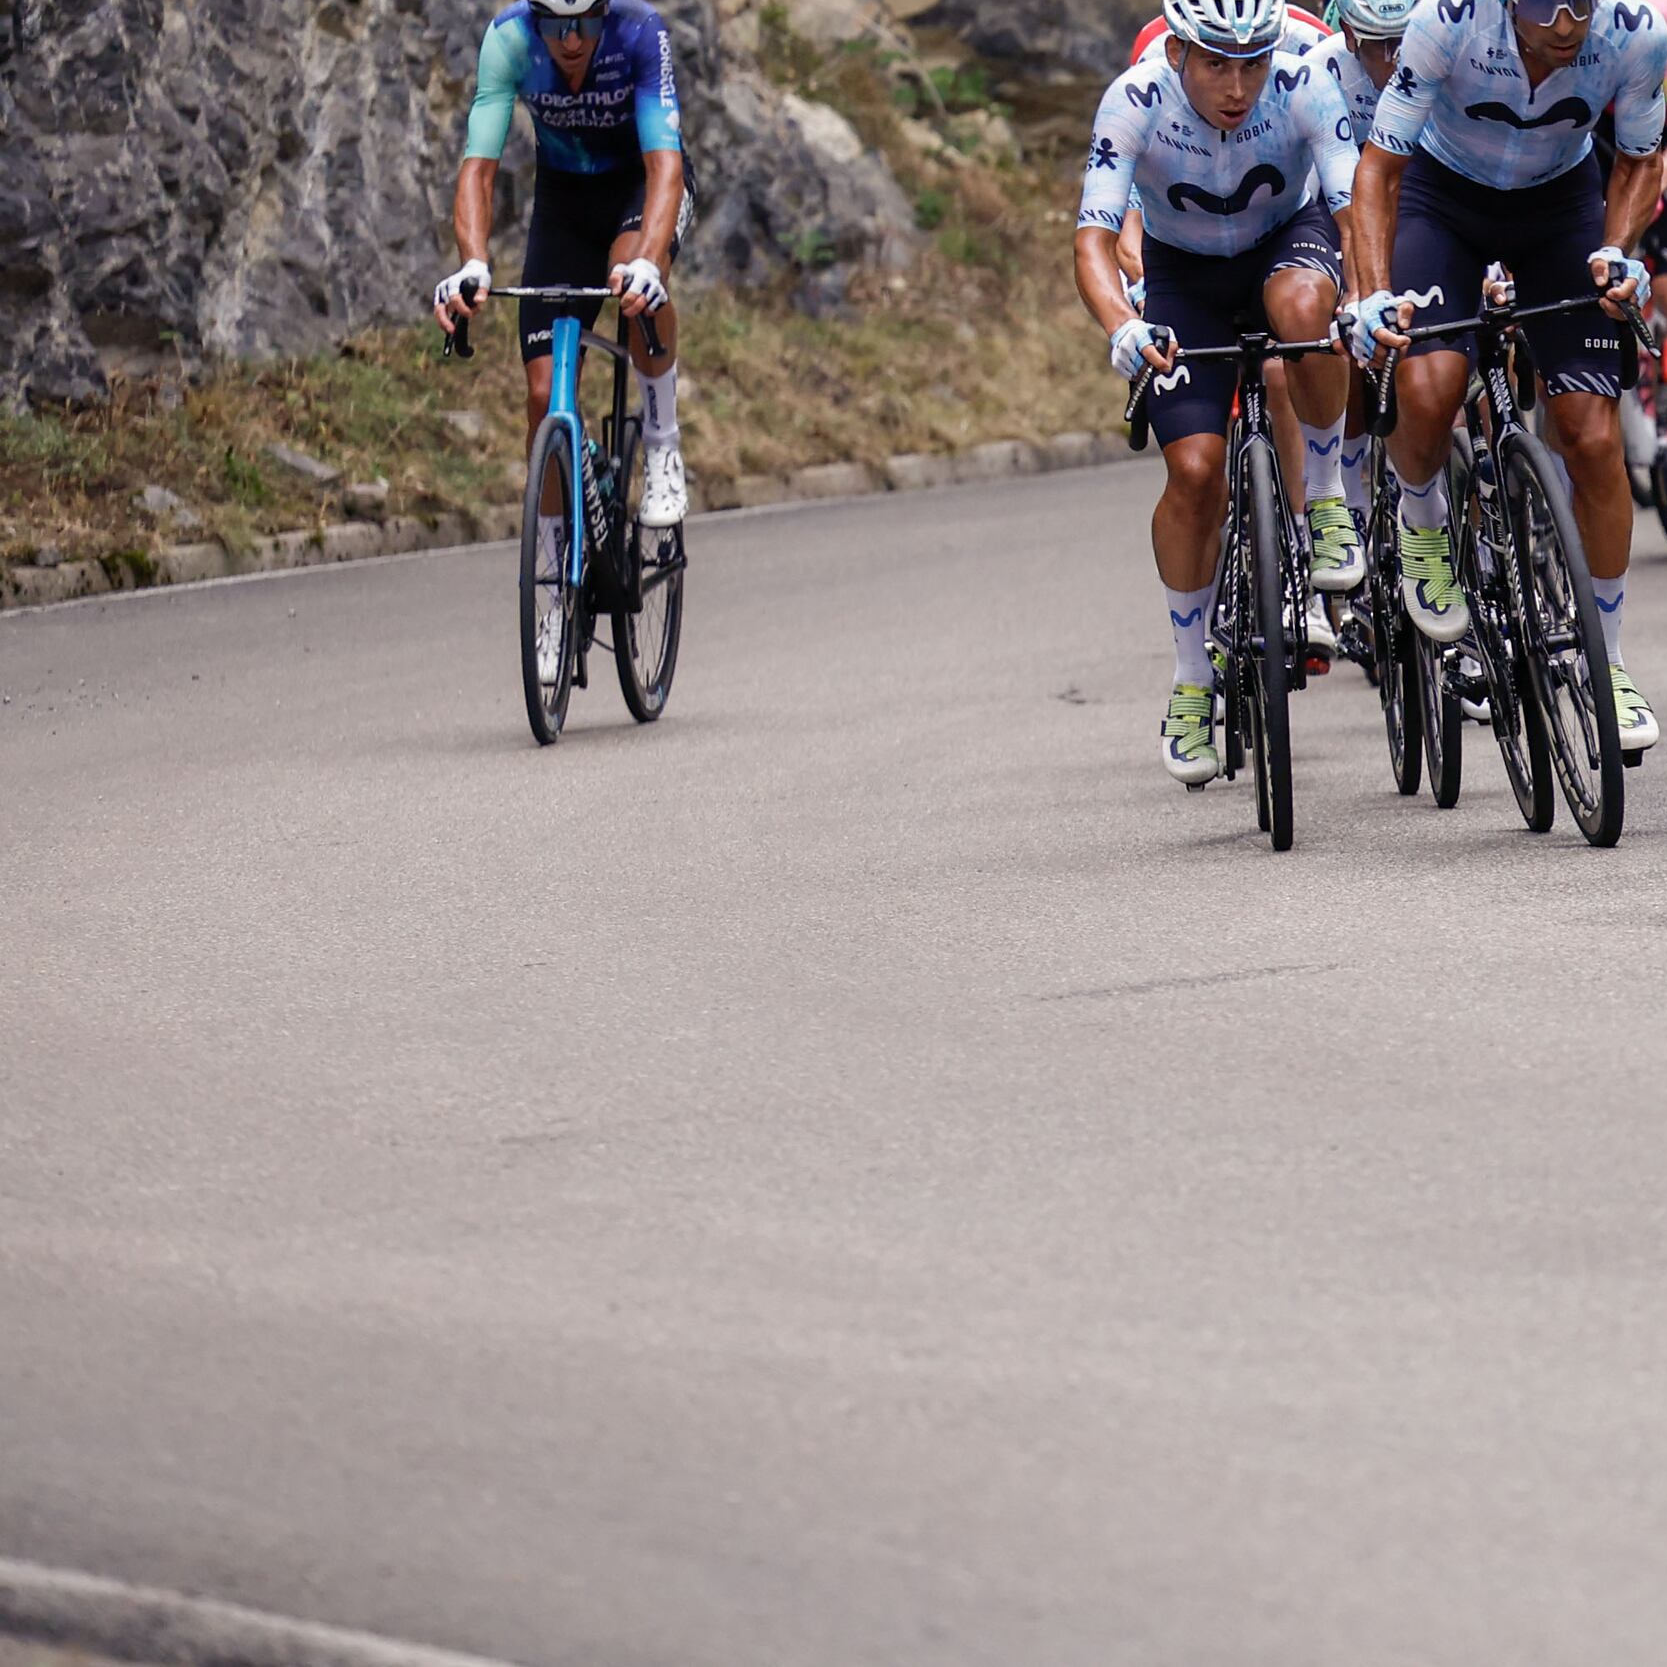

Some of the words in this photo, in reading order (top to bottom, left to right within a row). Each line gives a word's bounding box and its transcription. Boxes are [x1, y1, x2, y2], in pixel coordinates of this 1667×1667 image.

[1470, 57, 1522, 80] CANYON
[1566, 52, 1601, 69] OBIK
[1236, 118, 1273, 144] GOBIK
[1156, 130, 1212, 158] CANYON
[1585, 337, 1621, 351] GOBIK
